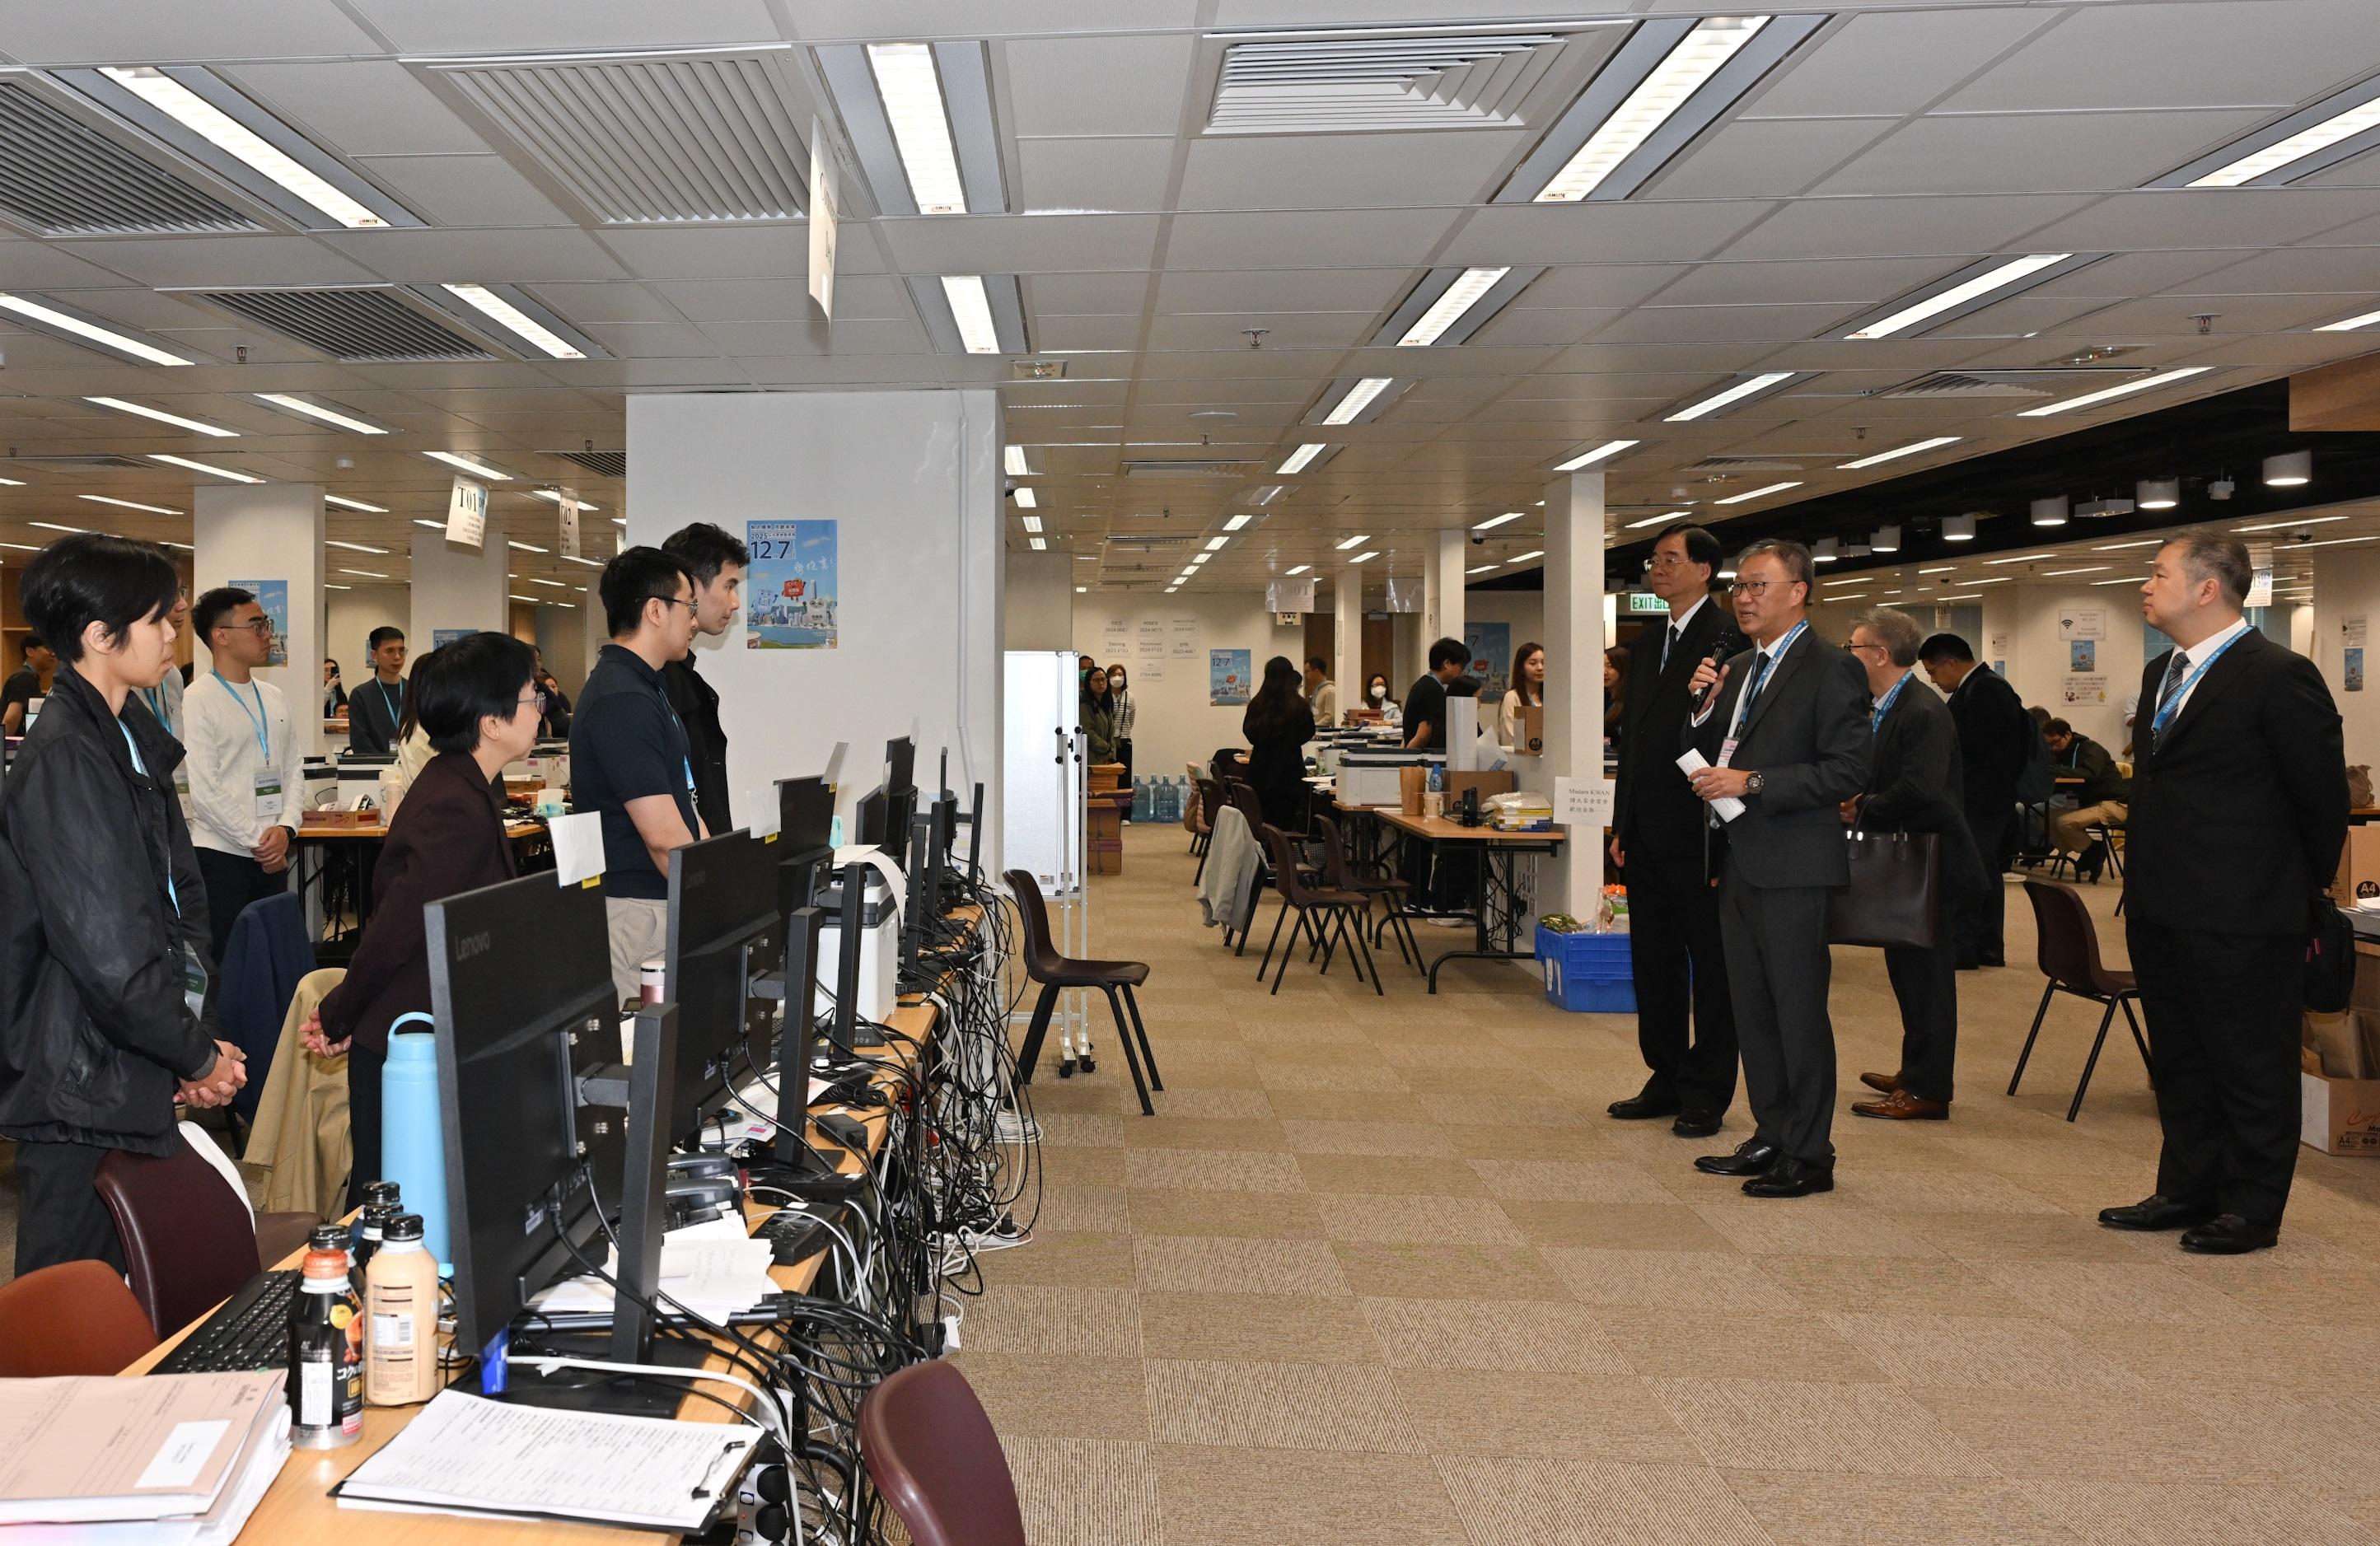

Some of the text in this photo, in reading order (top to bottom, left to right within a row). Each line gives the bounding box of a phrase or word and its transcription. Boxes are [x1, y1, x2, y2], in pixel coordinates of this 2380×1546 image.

[458, 486, 476, 511] T01
[750, 541, 791, 559] 12 7
[1633, 596, 1653, 610] EXIT
[2360, 883, 2377, 893] A4
[455, 931, 490, 962] Lenovo
